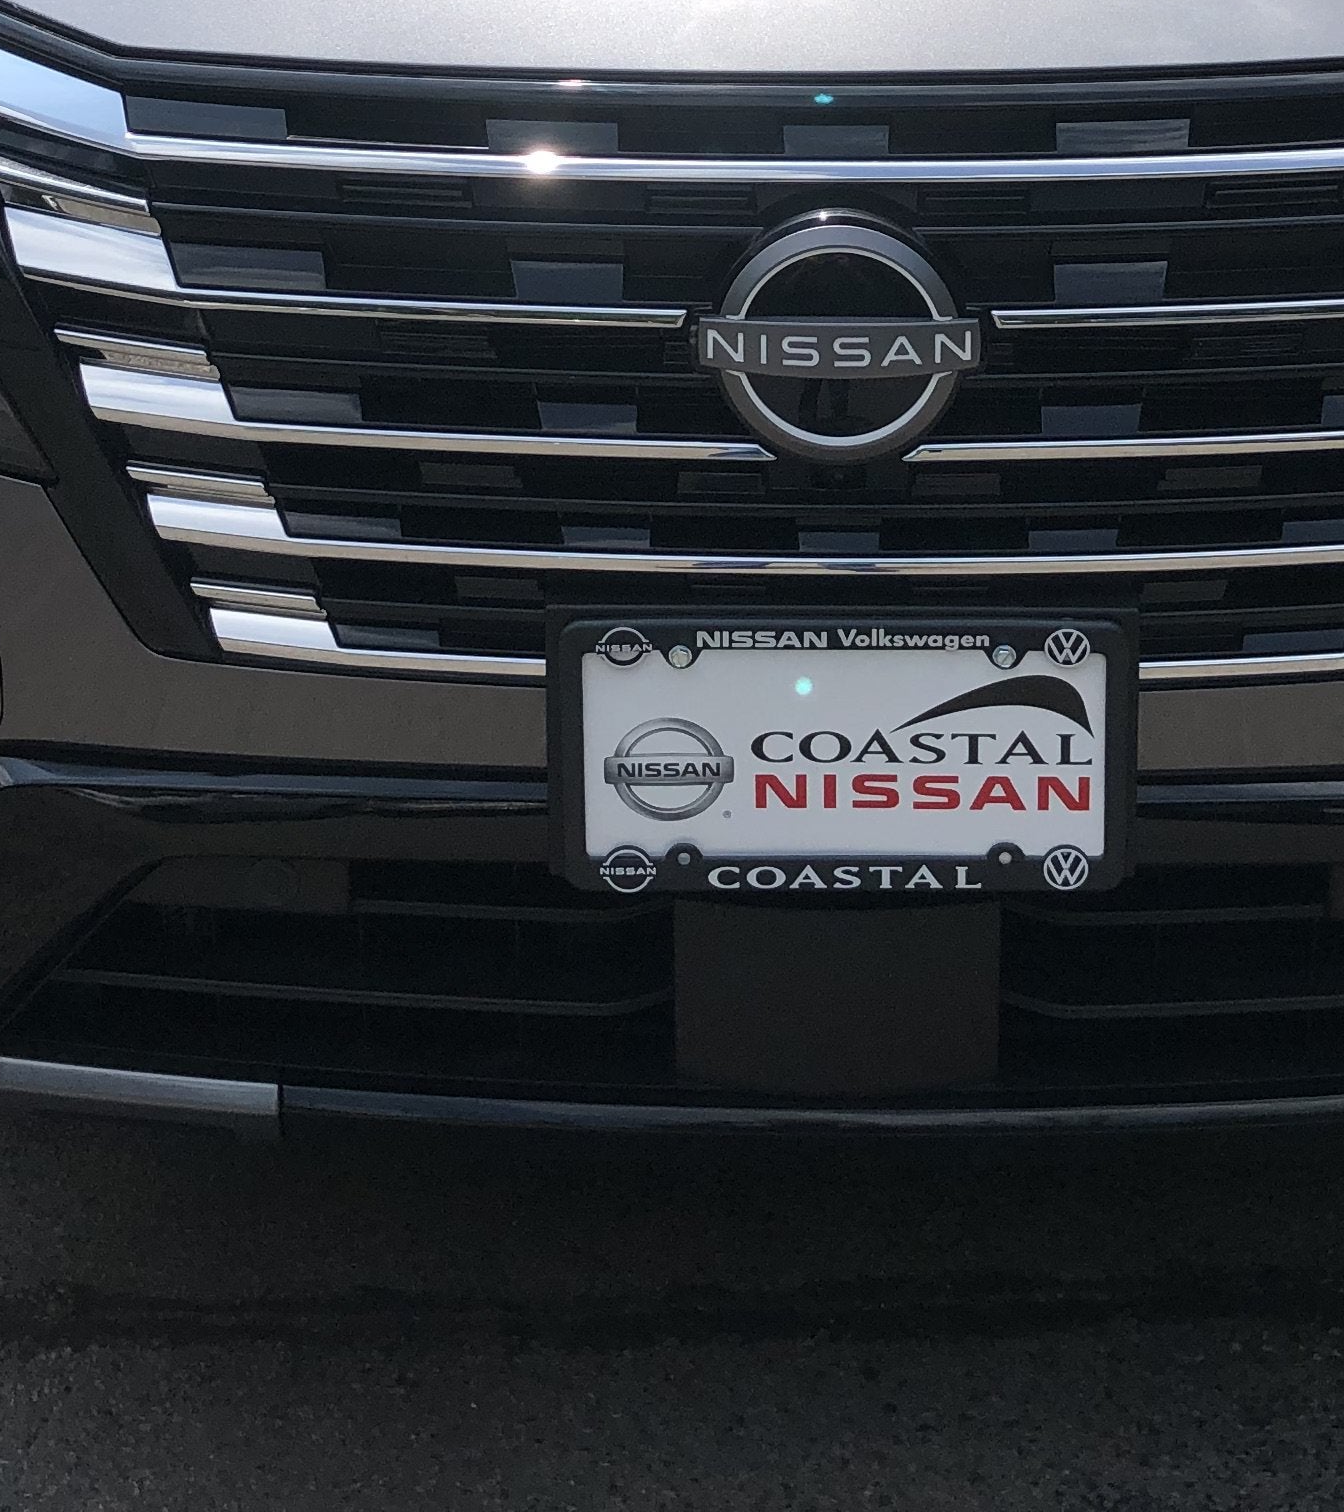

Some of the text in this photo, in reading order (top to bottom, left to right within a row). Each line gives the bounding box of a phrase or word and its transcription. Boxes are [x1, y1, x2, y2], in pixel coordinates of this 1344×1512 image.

[706, 329, 972, 367] NISSAN
[595, 643, 652, 652] NISSAN
[696, 628, 990, 651] NISSAN Volkswagen
[750, 729, 1093, 765] COASTAL
[617, 762, 721, 778] NISSAN
[754, 774, 1091, 810] NISSAN
[599, 866, 657, 876] NISSAN
[707, 865, 982, 889] COASTAL
